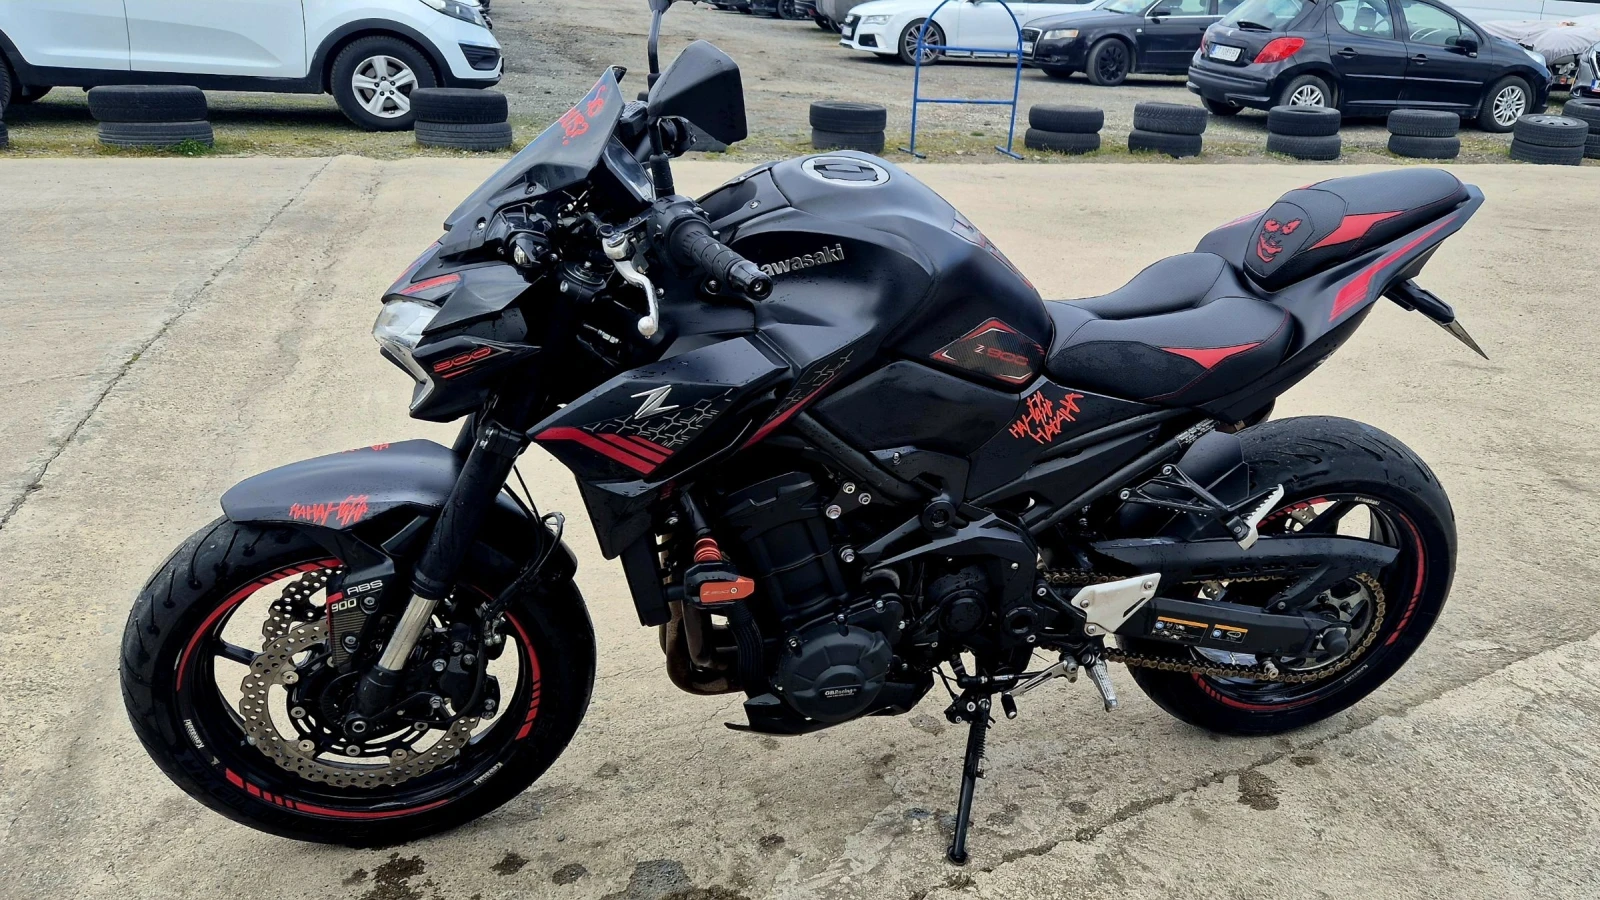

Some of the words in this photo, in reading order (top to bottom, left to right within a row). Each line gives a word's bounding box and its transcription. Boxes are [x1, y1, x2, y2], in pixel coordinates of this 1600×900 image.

[760, 243, 845, 277] awasaki
[433, 346, 491, 373] 900
[346, 579, 384, 596] ABS
[331, 597, 357, 613] 900
